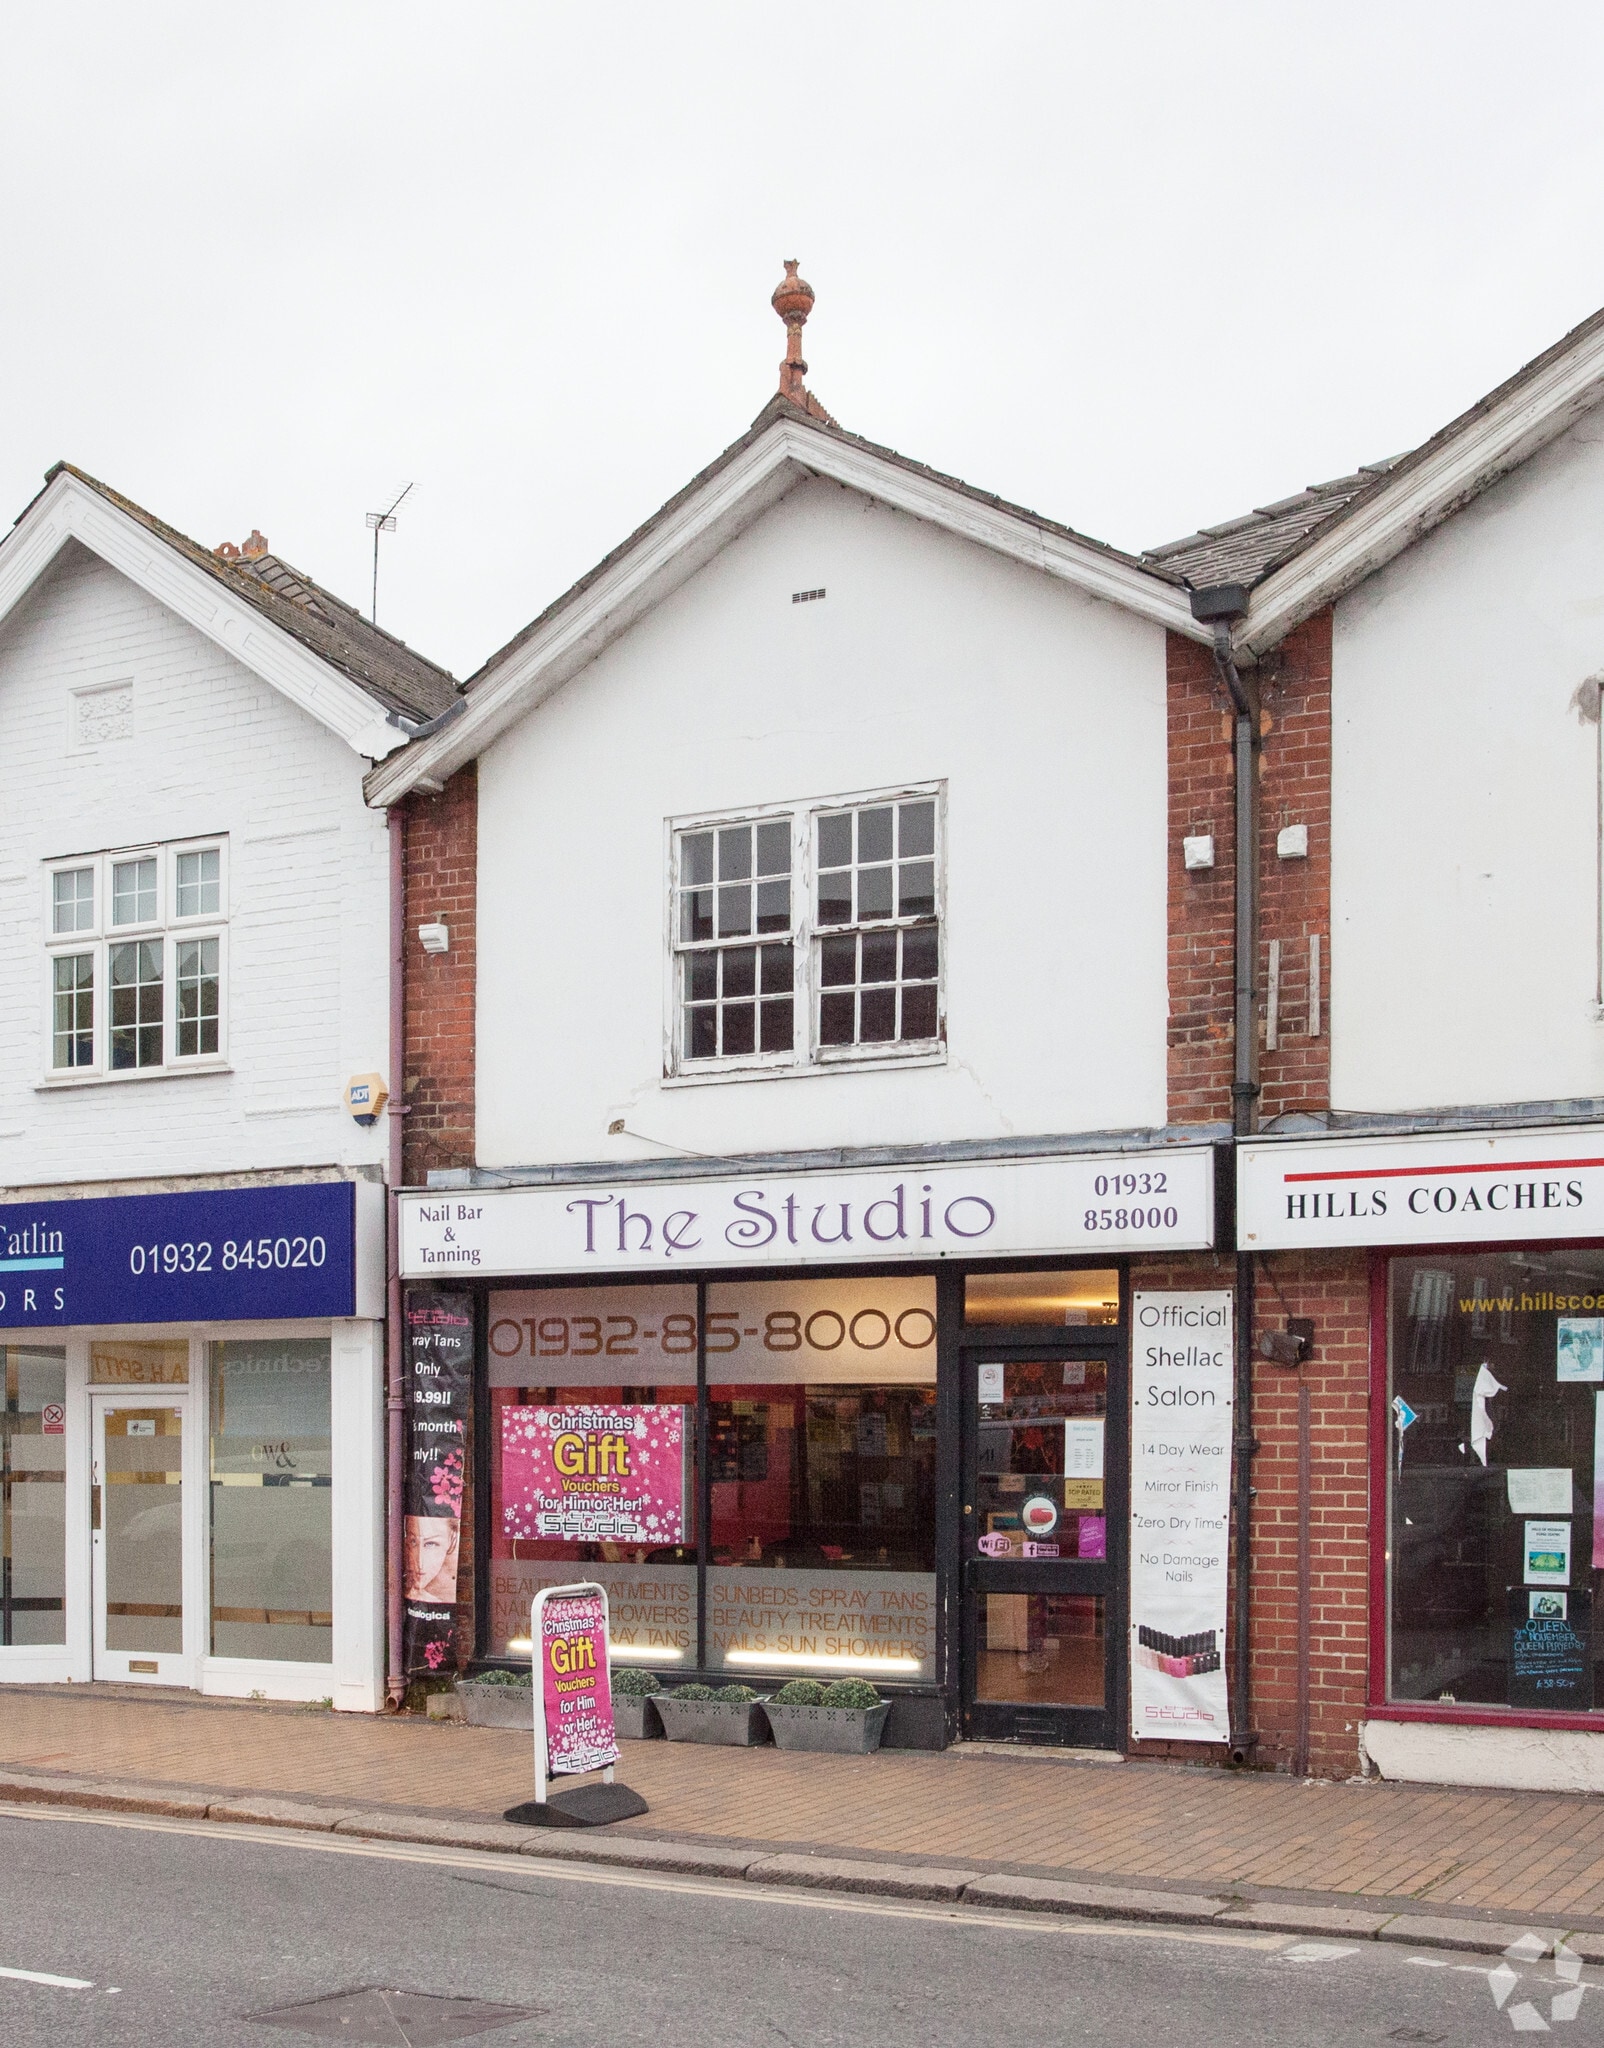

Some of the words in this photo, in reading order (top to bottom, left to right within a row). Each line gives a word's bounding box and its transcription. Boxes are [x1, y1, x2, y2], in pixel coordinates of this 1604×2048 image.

[351, 1088, 369, 1102] ADT
[1094, 1172, 1168, 1197] 01932
[1286, 1190, 1388, 1219] HILLS
[1408, 1180, 1583, 1215] COACHES
[419, 1205, 451, 1222] Nail
[457, 1205, 483, 1221] Bar
[566, 1194, 702, 1257] The
[724, 1183, 996, 1249] Studio
[1084, 1206, 1178, 1231] 858000
[443, 1226, 457, 1242] &
[130, 1242, 212, 1275] 01932
[222, 1236, 327, 1271] 845020
[420, 1247, 481, 1266] Tanning
[1140, 1305, 1227, 1328] Official
[434, 1333, 461, 1348] Tans
[1146, 1346, 1223, 1367] Shellac
[415, 1362, 441, 1377] Only
[413, 1391, 451, 1405] 9.99!!
[1147, 1385, 1215, 1407] Salon
[418, 1420, 457, 1434] month
[548, 1412, 635, 1431] Christmas
[414, 1447, 438, 1462] nly!!
[553, 1433, 631, 1476] Gift
[1141, 1444, 1155, 1455] 14
[1159, 1444, 1185, 1458] Day
[1189, 1444, 1224, 1456] Wear
[561, 1479, 620, 1493] Vouchers
[1145, 1480, 1181, 1492] Mirror
[1185, 1480, 1219, 1492] Finish
[539, 1495, 558, 1510] for
[562, 1496, 591, 1511] Him
[594, 1499, 609, 1511] or
[613, 1497, 643, 1511] Her!
[544, 1512, 638, 1534] Studio
[1137, 1516, 1166, 1529] Zero
[1170, 1517, 1191, 1531] Dry
[1194, 1517, 1224, 1530] Time
[1140, 1553, 1159, 1565] No
[1163, 1553, 1219, 1569] Damage
[1165, 1571, 1193, 1582] Nails
[543, 1615, 595, 1636] Christmas
[1526, 1619, 1571, 1632] QUEEN
[550, 1635, 597, 1675] Gift
[1514, 1641, 1545, 1653] QUEEN
[555, 1675, 596, 1694] Vouchers
[560, 1697, 575, 1715] for
[576, 1694, 596, 1711] Him
[564, 1721, 575, 1736] or
[576, 1717, 597, 1732] Her!
